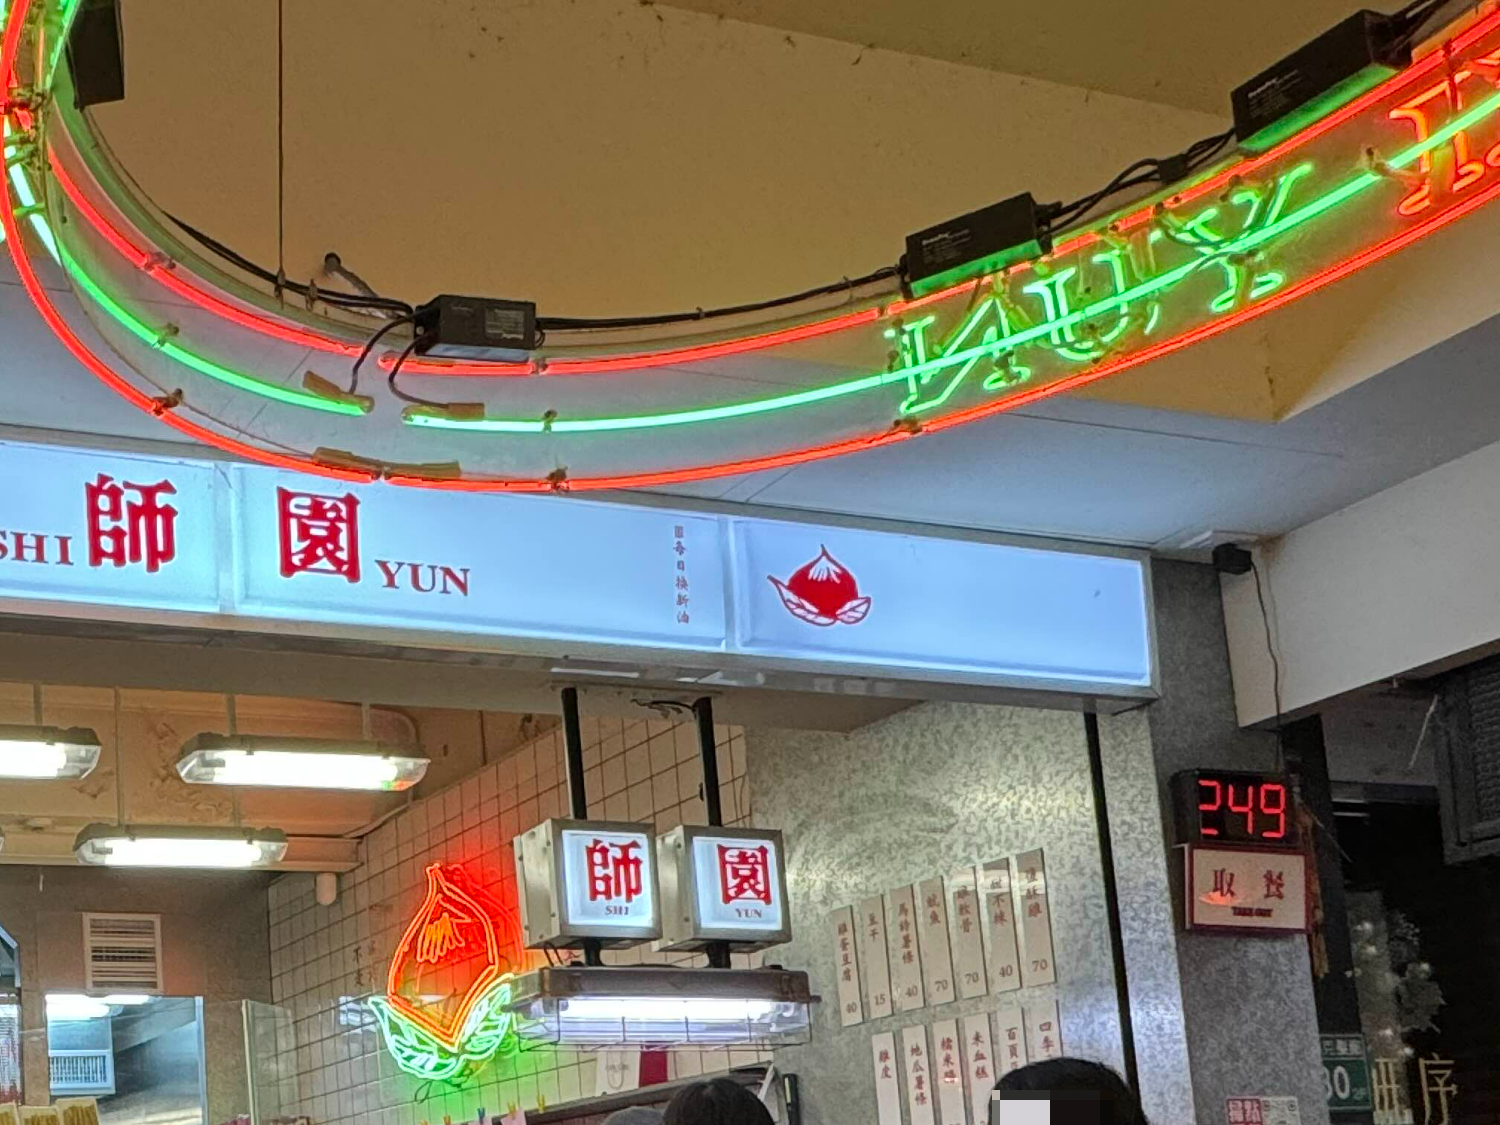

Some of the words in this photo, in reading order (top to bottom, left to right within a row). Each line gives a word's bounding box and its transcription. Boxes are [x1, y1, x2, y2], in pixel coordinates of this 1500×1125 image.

[85, 473, 177, 574] 師
[276, 485, 362, 584] 園
[374, 559, 470, 597] YUN
[1198, 779, 1286, 838] 249
[585, 838, 644, 903] 師
[717, 843, 772, 905] 園
[604, 905, 630, 916] SHI
[735, 907, 763, 919] YUN
[999, 964, 1013, 978] 40
[1032, 958, 1048, 972] 70
[964, 972, 979, 984] 70
[905, 985, 918, 998] 40
[934, 979, 948, 991] 70
[874, 993, 886, 1006] 15
[845, 1002, 858, 1014] 40
[1039, 1021, 1055, 1057] 四季
